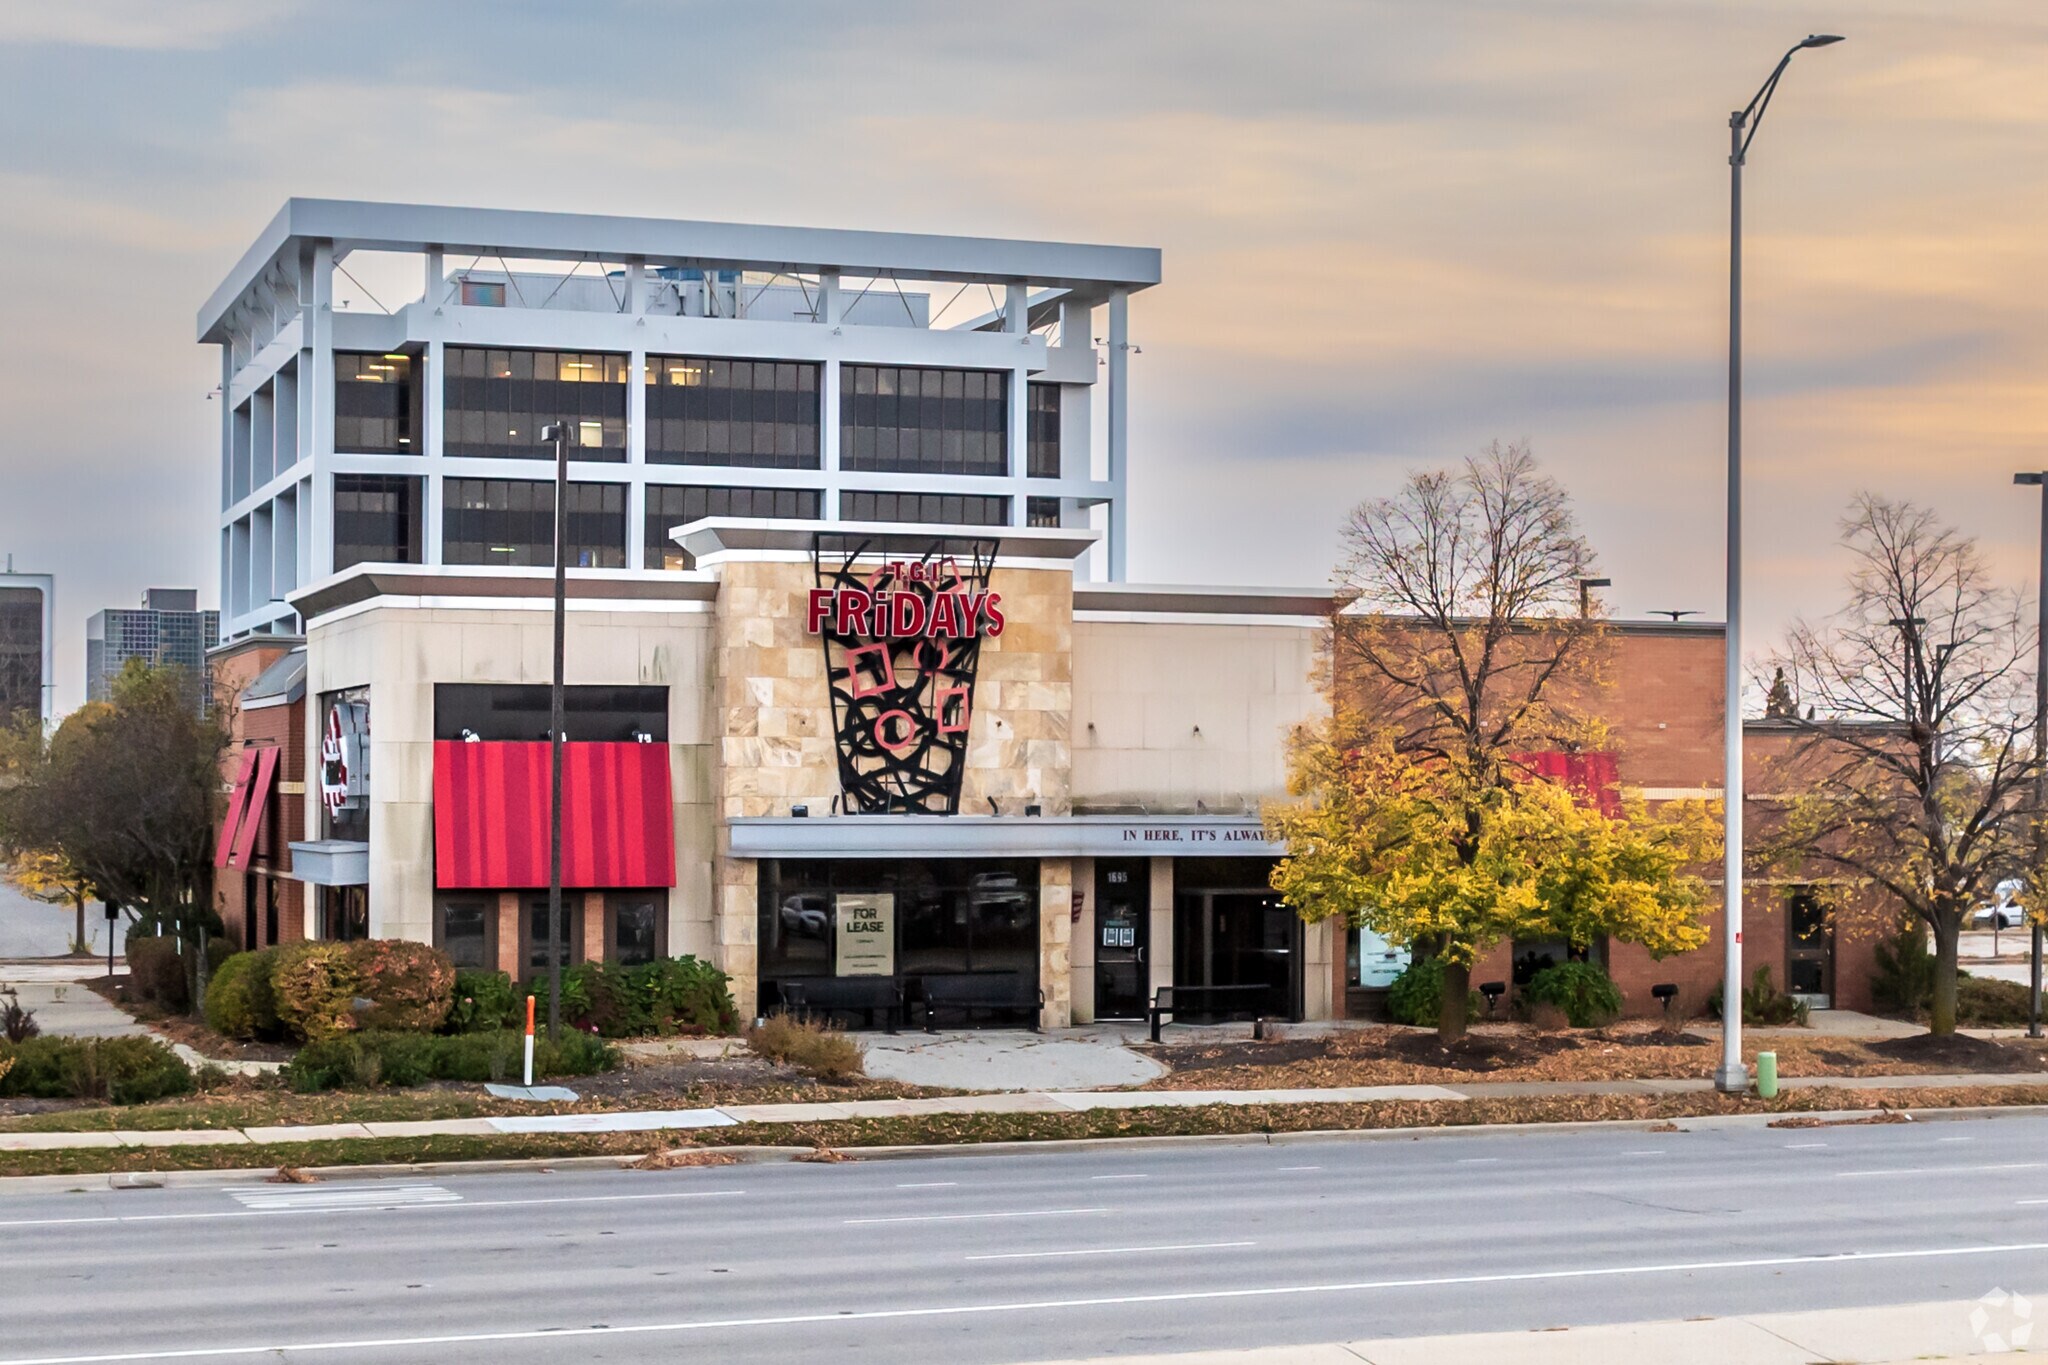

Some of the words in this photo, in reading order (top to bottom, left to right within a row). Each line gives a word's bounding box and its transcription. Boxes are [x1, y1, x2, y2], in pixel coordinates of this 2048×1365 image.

[1123, 830, 1137, 841] IN
[1144, 830, 1184, 842] HERE,
[1191, 830, 1217, 841] IT'S
[1223, 830, 1272, 841] ALWAY
[853, 908, 877, 920] FOR
[846, 921, 884, 933] LEASE
